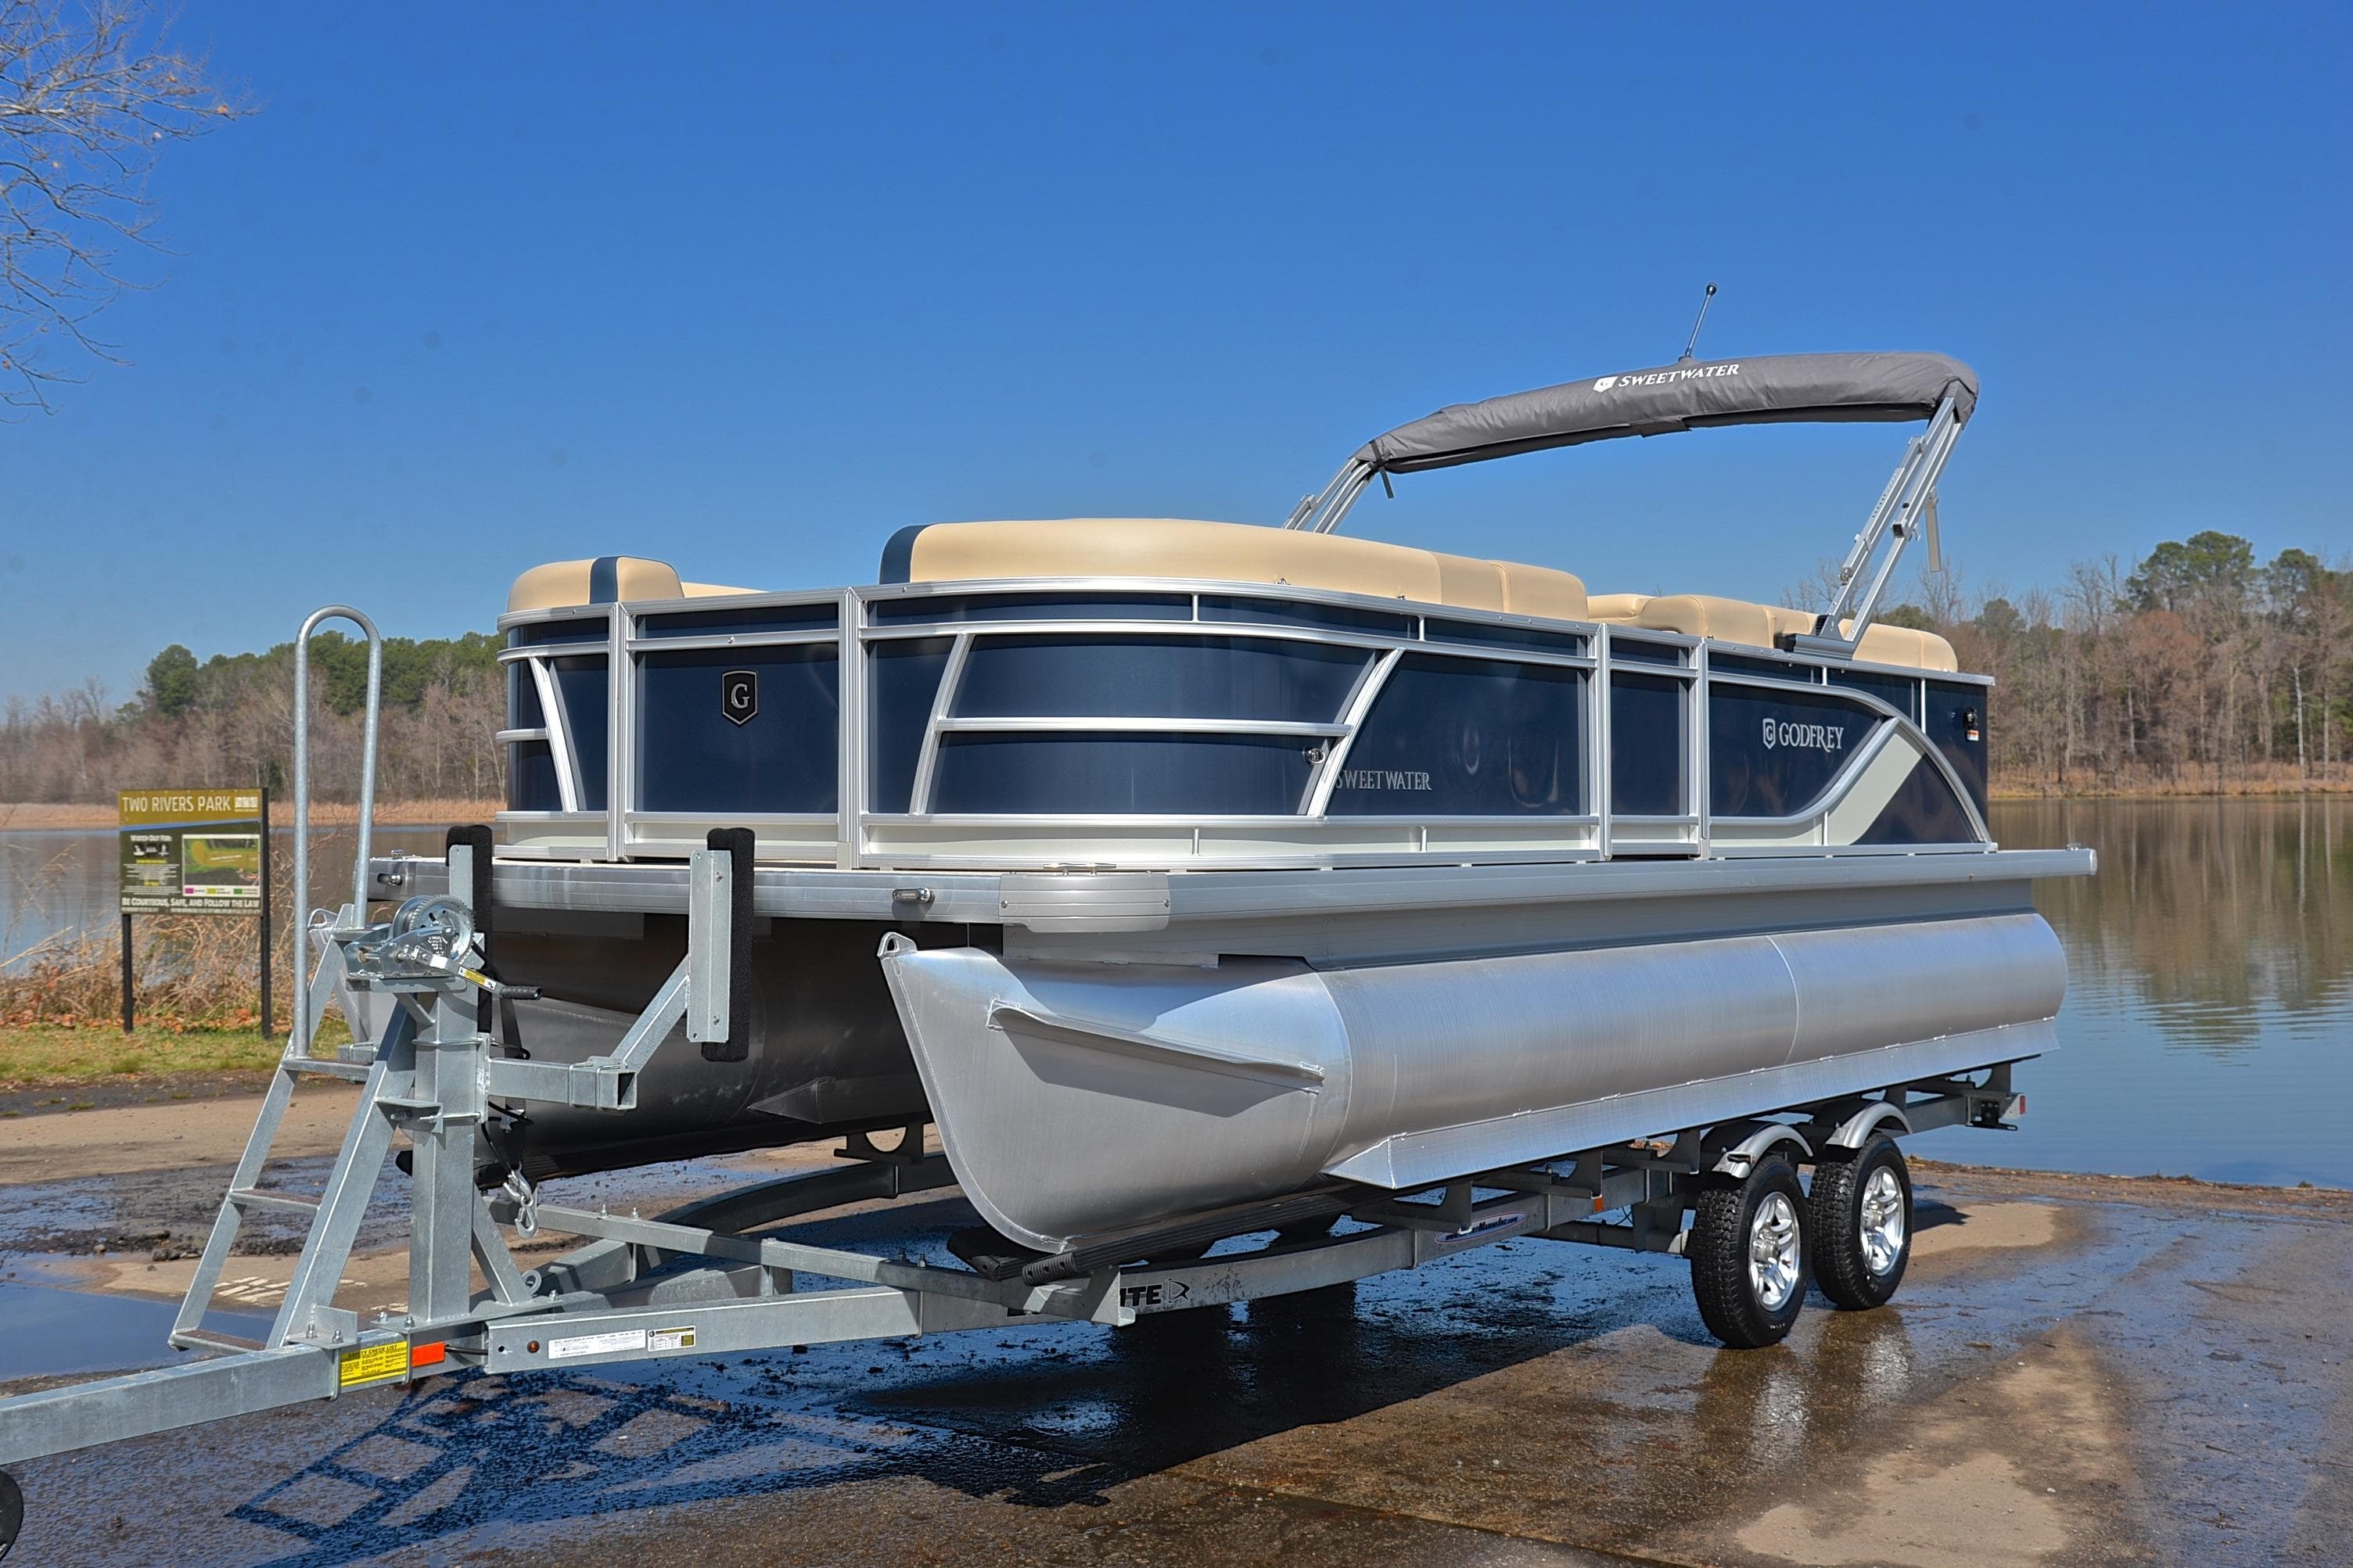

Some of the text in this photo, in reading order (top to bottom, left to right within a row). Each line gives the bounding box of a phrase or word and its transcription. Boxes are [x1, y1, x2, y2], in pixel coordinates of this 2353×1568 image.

[1618, 364, 1740, 387] SWEETWATER
[731, 683, 751, 709] G
[1766, 722, 1845, 752] G GODFREY
[122, 797, 149, 813] TWO
[152, 796, 194, 812] RIVERS
[198, 795, 232, 811] PARK
[1119, 1284, 1162, 1308] ITE
